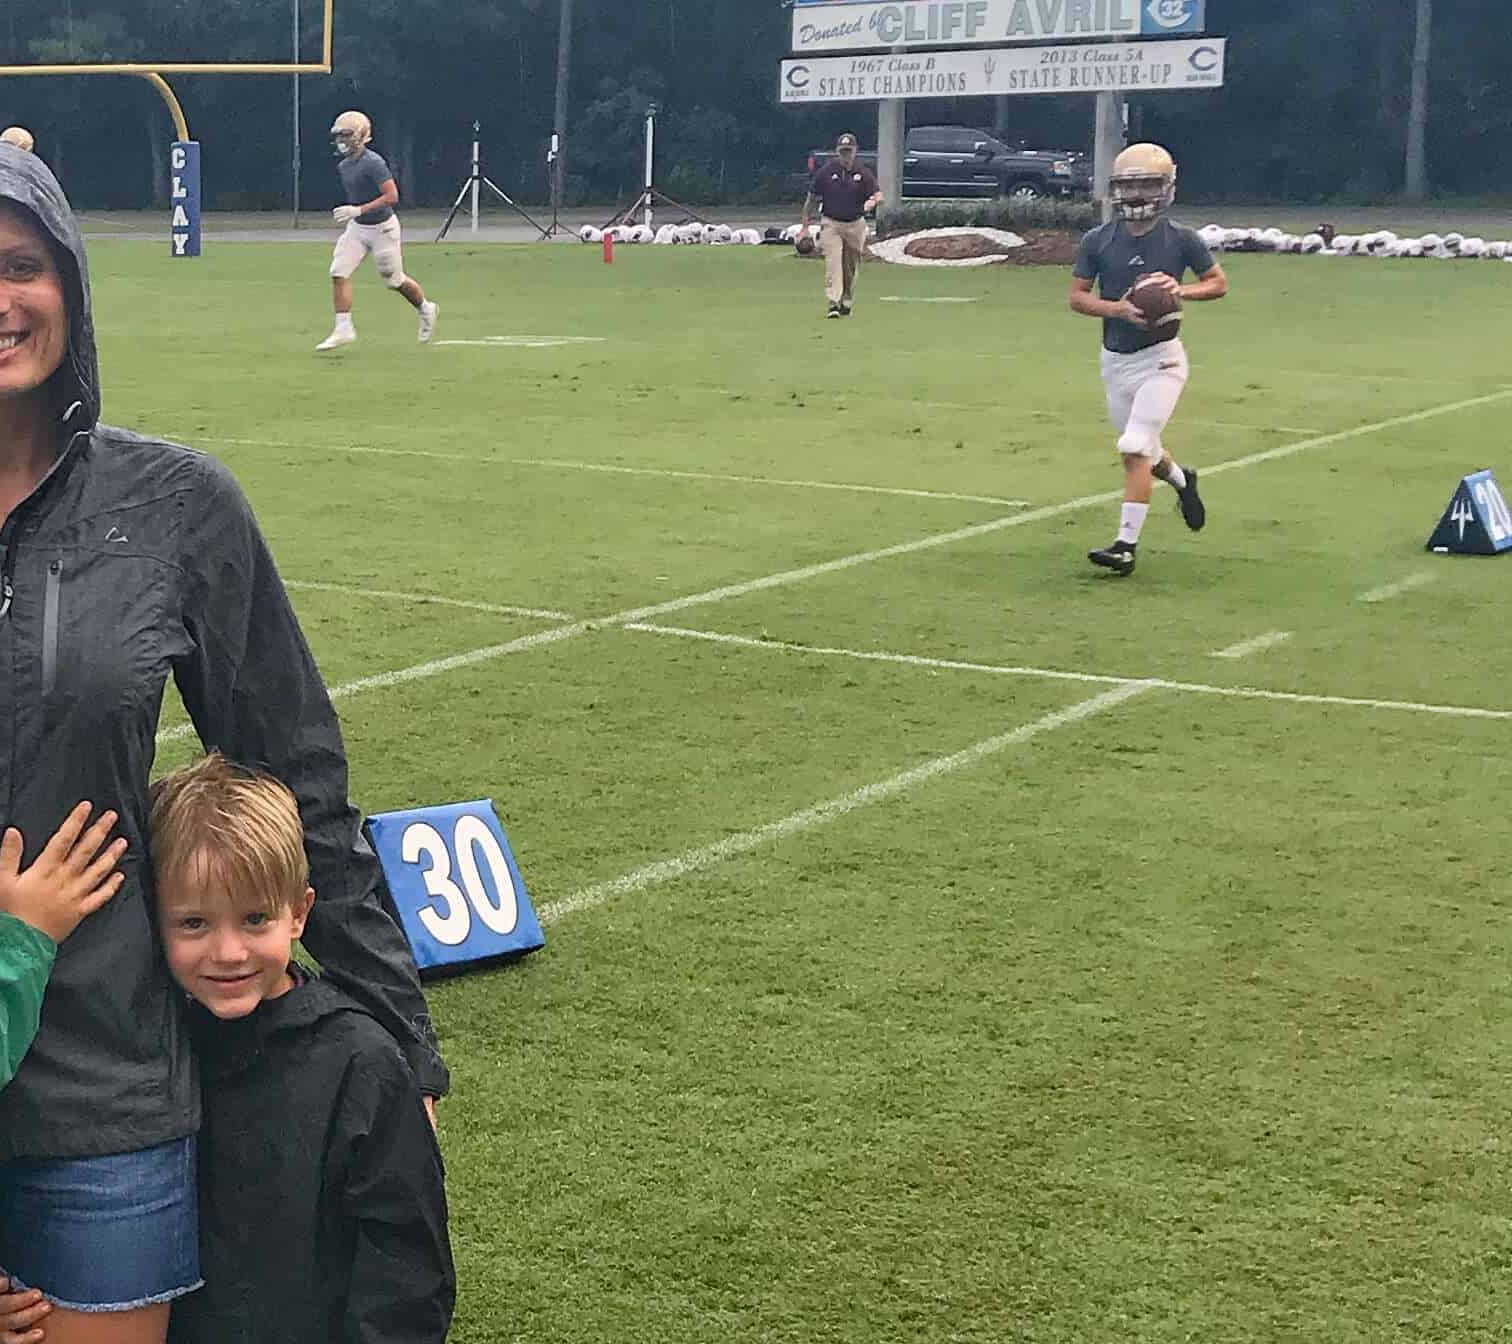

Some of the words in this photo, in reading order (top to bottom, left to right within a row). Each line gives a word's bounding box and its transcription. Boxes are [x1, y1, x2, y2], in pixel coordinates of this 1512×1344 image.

[1161, 0, 1184, 17] 32
[800, 16, 862, 44] Donated
[877, 1, 988, 43] CLIFF
[850, 60, 883, 74] 1967
[888, 58, 920, 71] Class
[926, 58, 935, 70] B
[1040, 50, 1076, 65] 2013
[1083, 49, 1119, 63] Class
[1126, 48, 1144, 62] 5A
[819, 77, 866, 97] STATE
[873, 72, 967, 95] CHAMPIONS
[1009, 68, 1062, 88] STATE
[1071, 63, 1171, 86] RUNNER-UP
[172, 148, 189, 255] CLAY
[402, 815, 517, 945] 30
